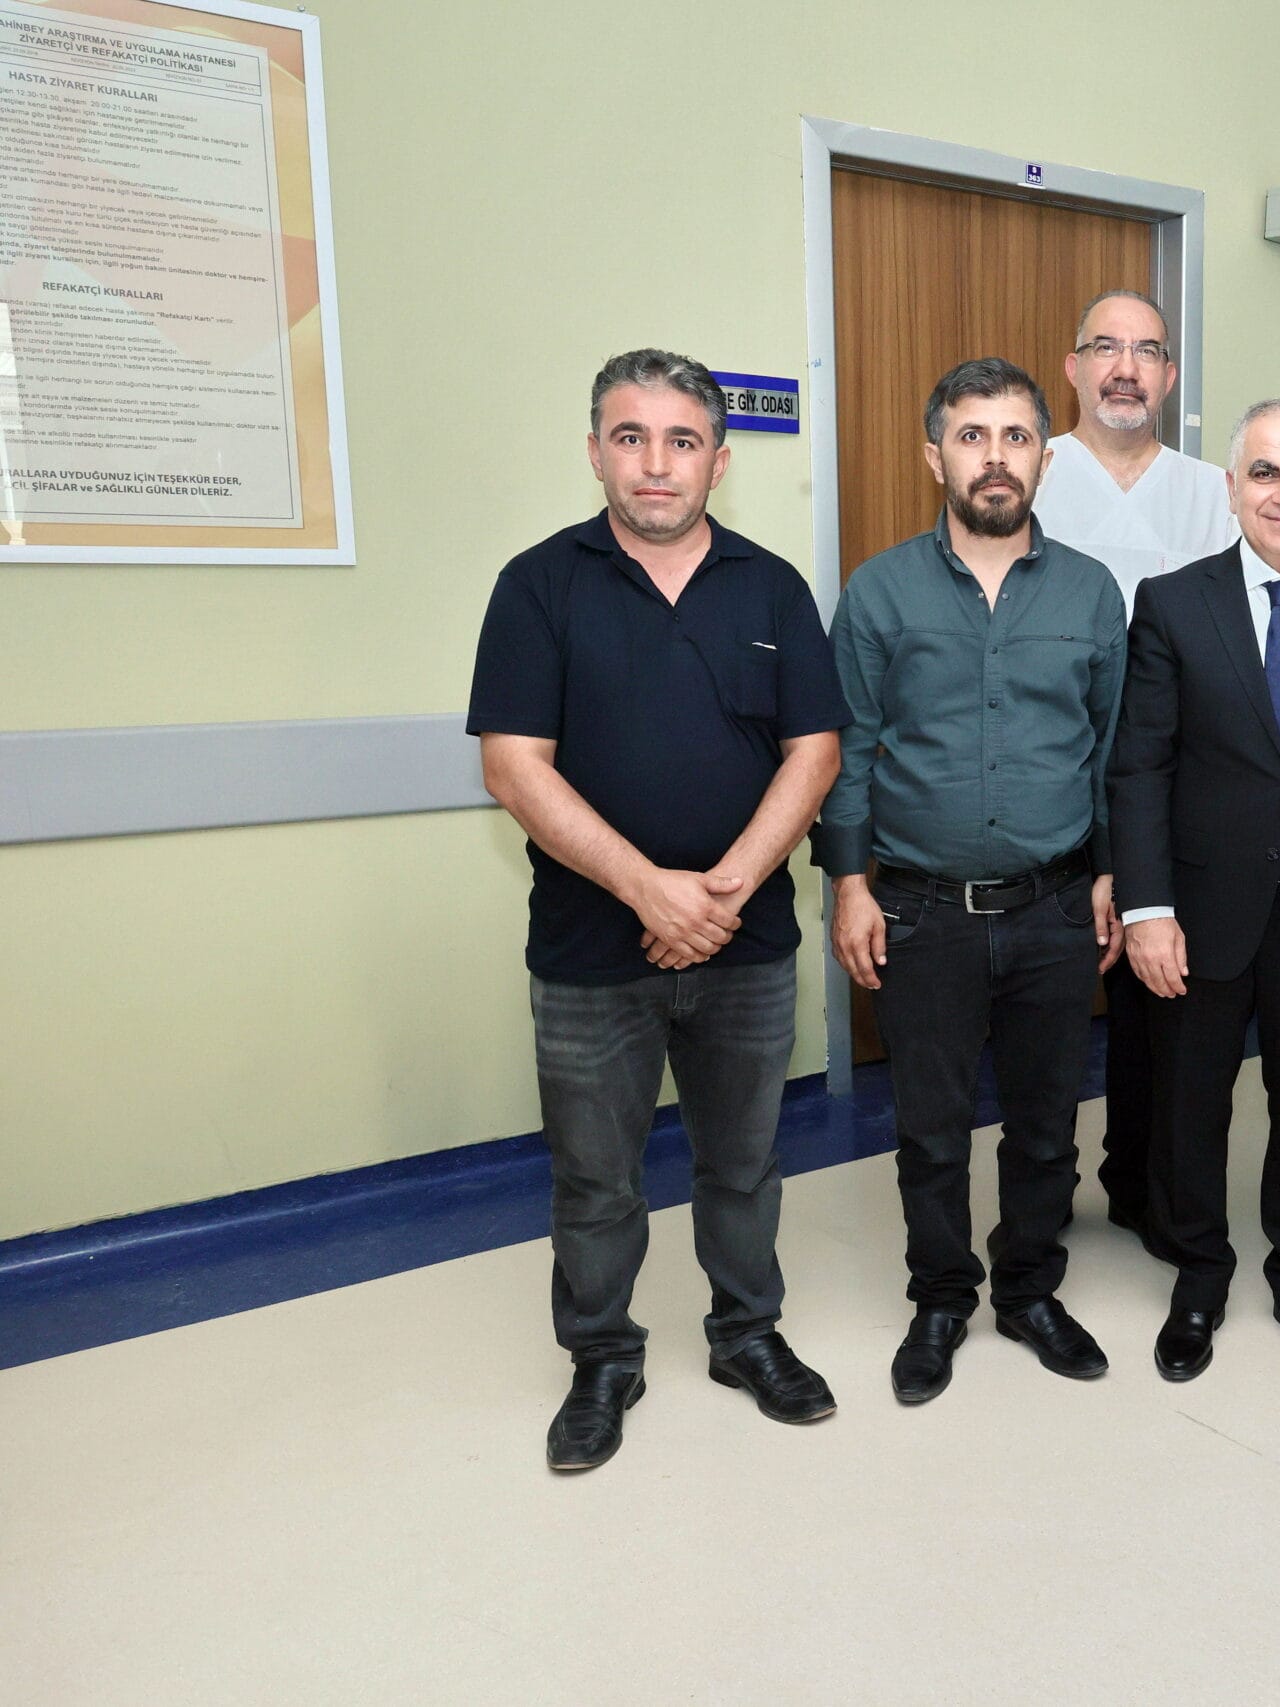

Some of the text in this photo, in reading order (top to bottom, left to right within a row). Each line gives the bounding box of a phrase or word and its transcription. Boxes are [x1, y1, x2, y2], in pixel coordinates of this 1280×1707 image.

[19, 33, 73, 51] ZİYARETÇİ
[75, 44, 89, 53] VE
[92, 47, 148, 64] REFAKATÇİ
[150, 57, 203, 72] POLİTİKASI
[47, 28, 107, 46] ARAŞTIRMA
[109, 39, 123, 48] VE
[125, 42, 181, 58] UYGULAMA
[183, 52, 236, 68] HASTANESİ
[9, 71, 157, 102] HASTA ZİYARET KURALLARI
[42, 282, 163, 301] REFAKATÇİ KURALLARI
[738, 390, 759, 412] GİY.
[761, 395, 794, 415] ODASI
[32, 481, 78, 492] ŞİFALAR
[95, 483, 143, 494] SAĞLIKLI
[145, 485, 188, 495] GÜNLER
[190, 486, 232, 496] DİLERİZ.
[59, 470, 132, 481] UYDUĞUNUZ
[134, 472, 155, 484] İÇİN
[156, 474, 211, 485] TEŞEKKÜR
[212, 476, 242, 486] EDER,
